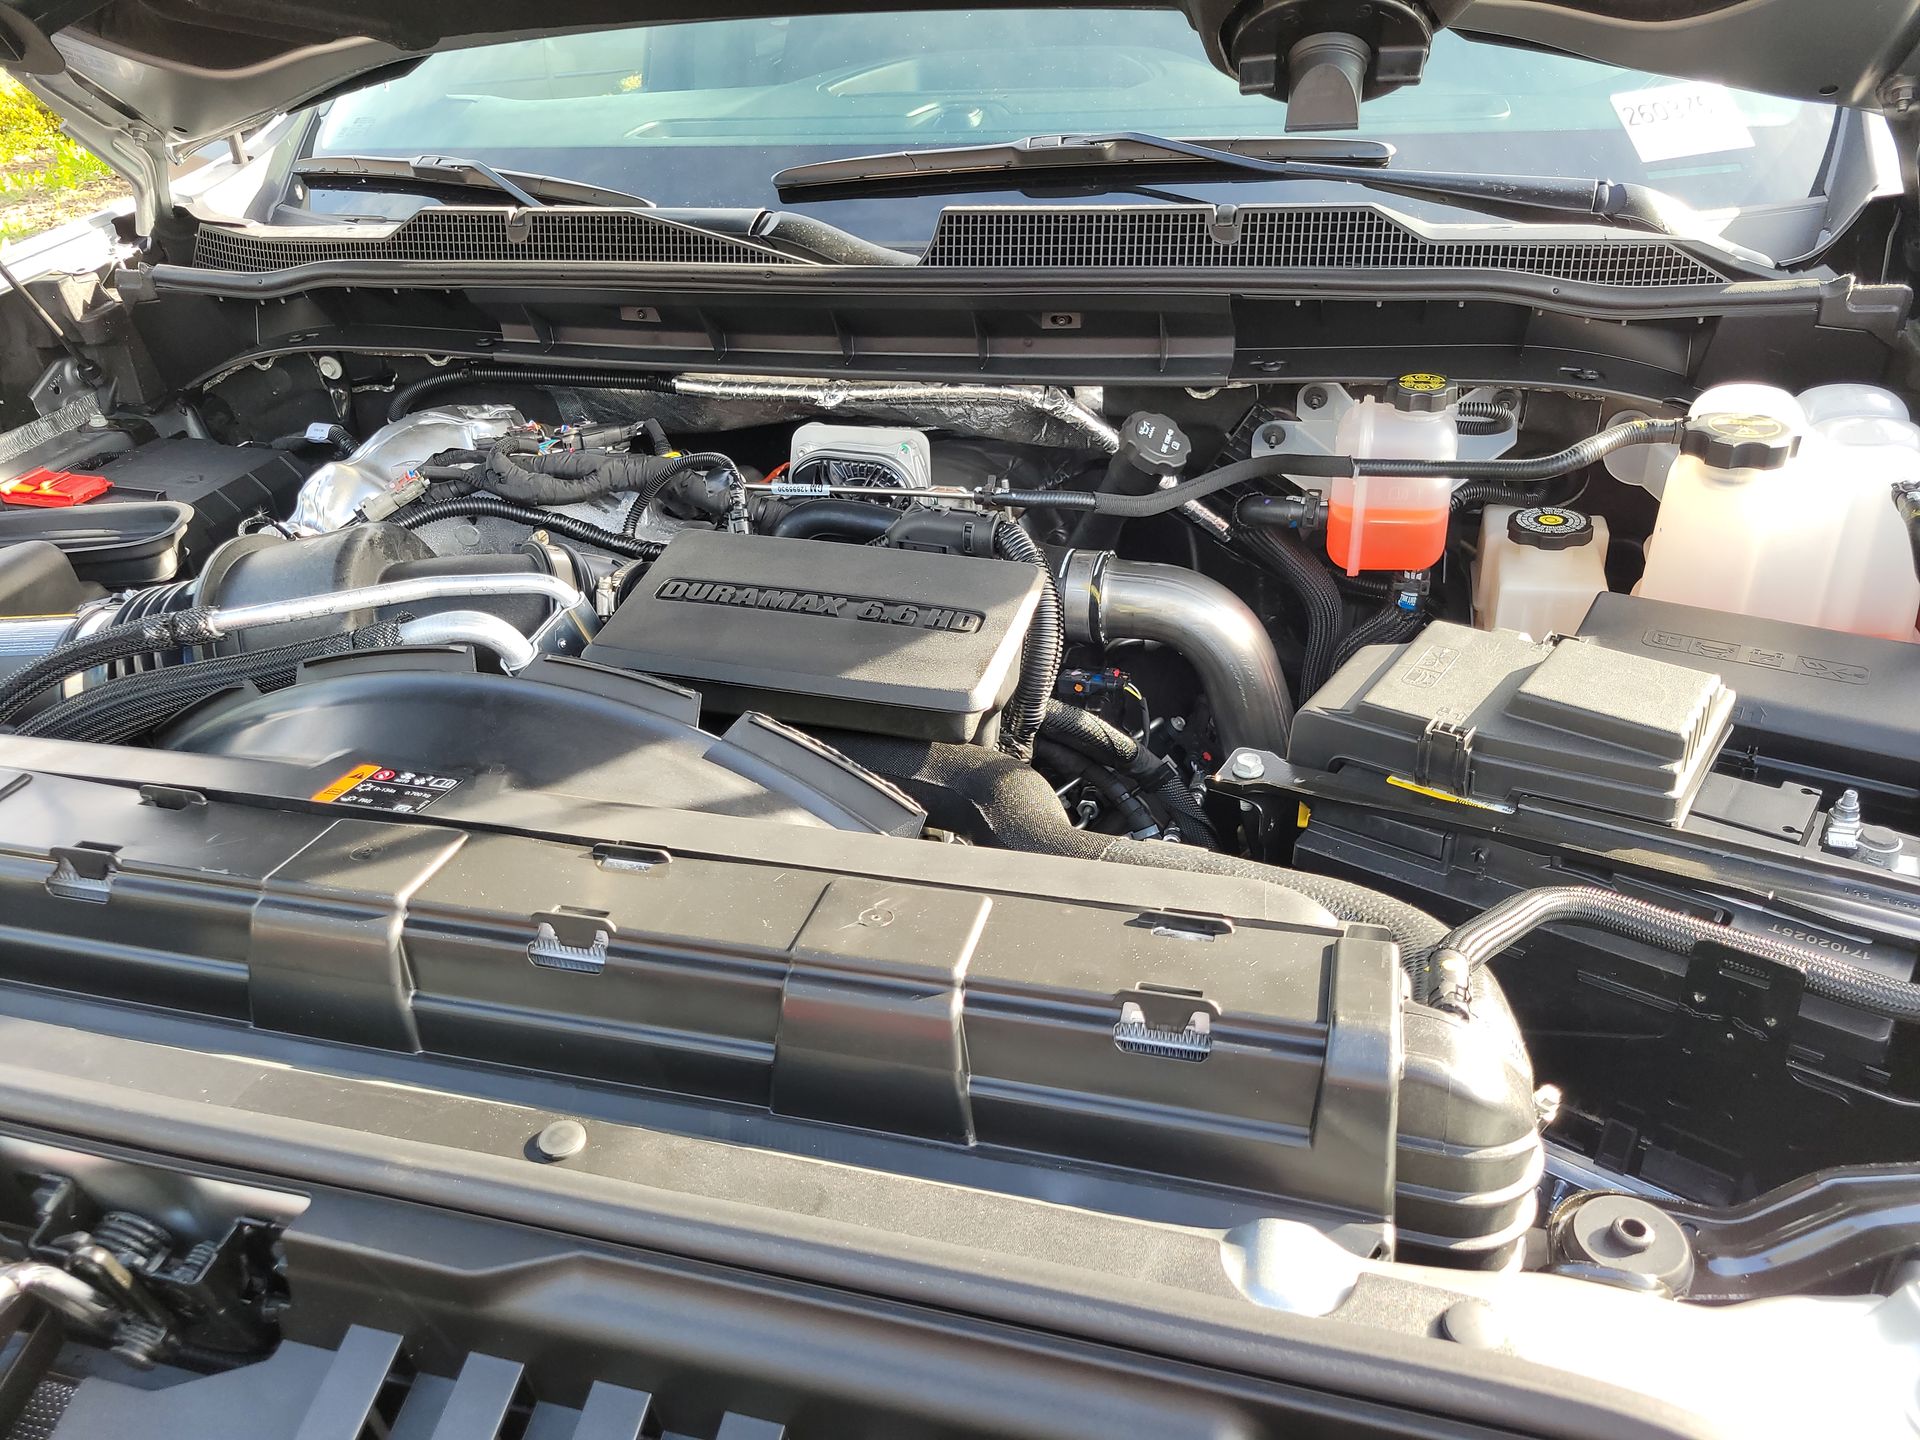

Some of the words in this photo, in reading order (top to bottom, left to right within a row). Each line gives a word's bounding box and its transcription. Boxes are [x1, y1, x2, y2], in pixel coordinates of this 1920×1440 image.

[664, 581, 848, 617] DURAMAX
[856, 600, 919, 625] 6.6
[924, 607, 982, 632] HD
[1767, 923, 1872, 961] 17102025T
